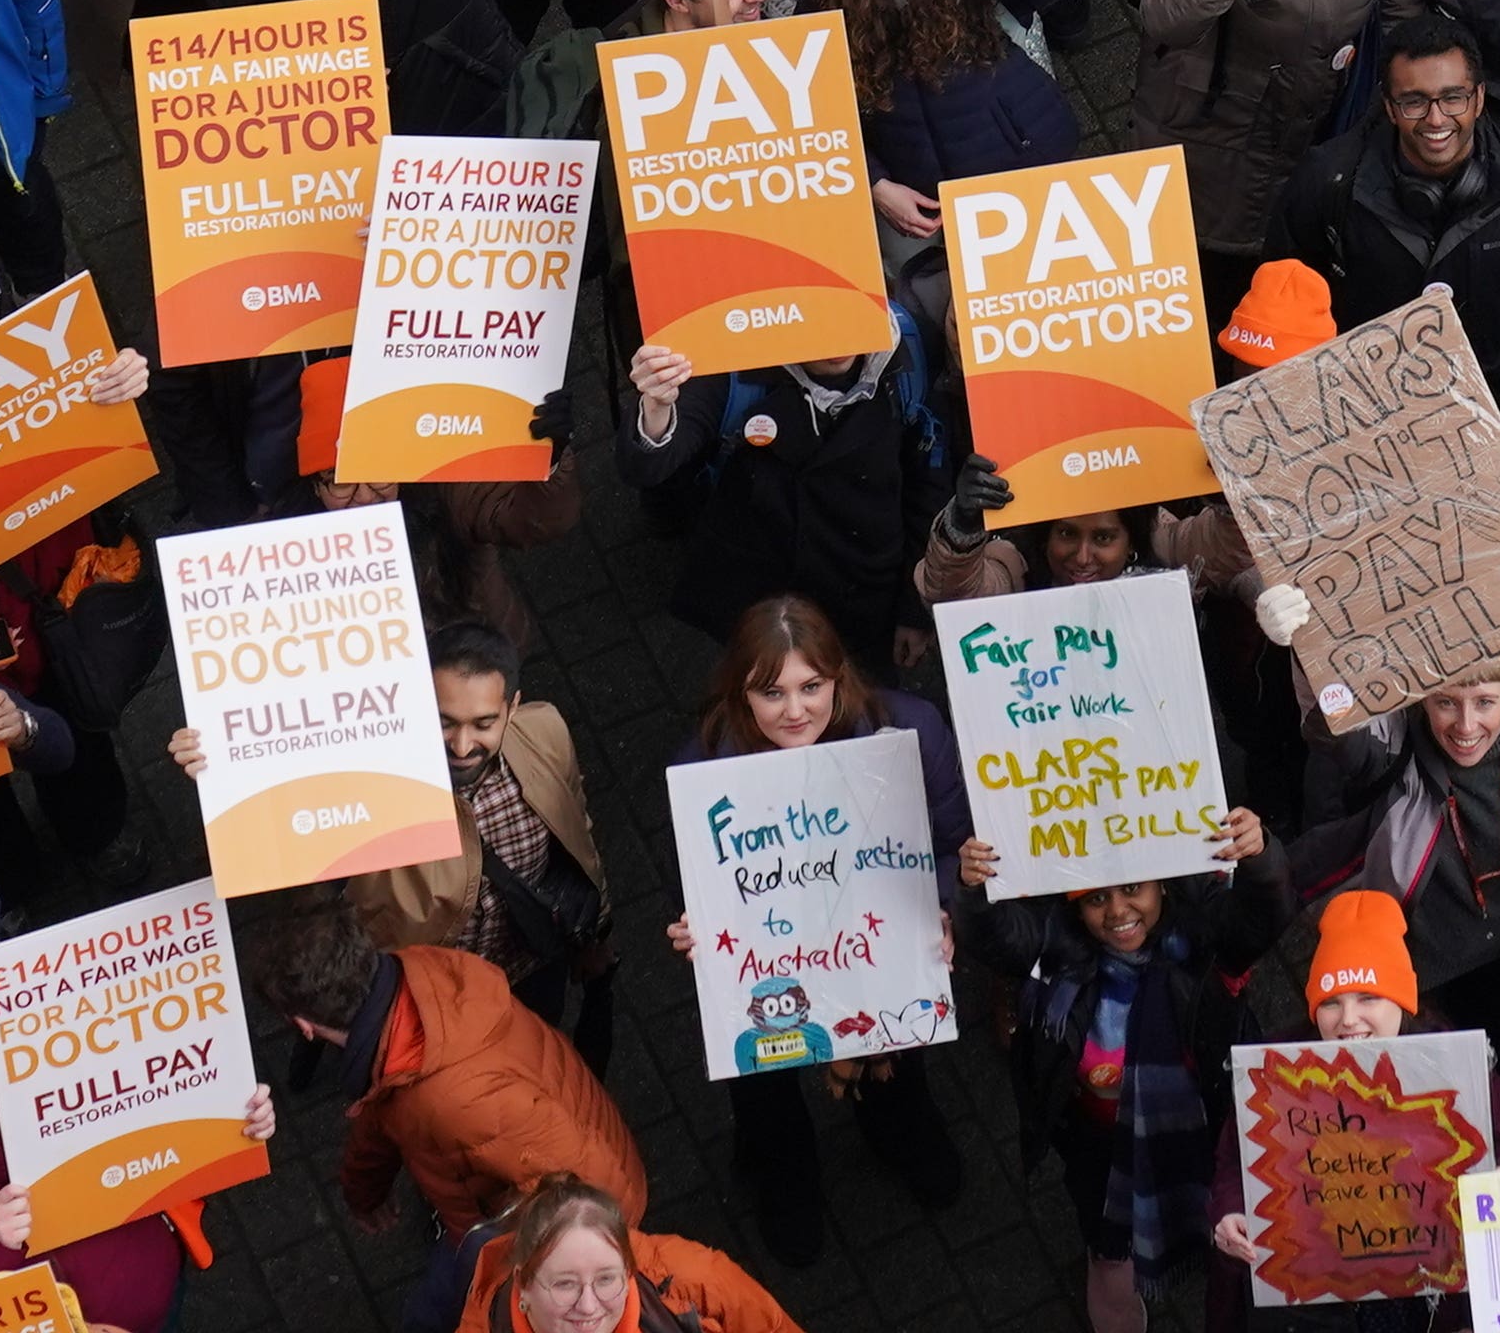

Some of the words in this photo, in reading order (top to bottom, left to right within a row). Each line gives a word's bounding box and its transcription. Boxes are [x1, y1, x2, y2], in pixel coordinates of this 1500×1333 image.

[1011, 667, 1065, 701] for
[1070, 693, 1133, 717] Work
[977, 737, 1118, 790] CLAPS
[1137, 760, 1200, 797] PAY
[708, 795, 784, 865] From
[786, 799, 849, 840] the
[1030, 819, 1088, 857] MY
[735, 849, 840, 903] Reduced
[854, 836, 934, 873] section
[764, 908, 793, 936] to
